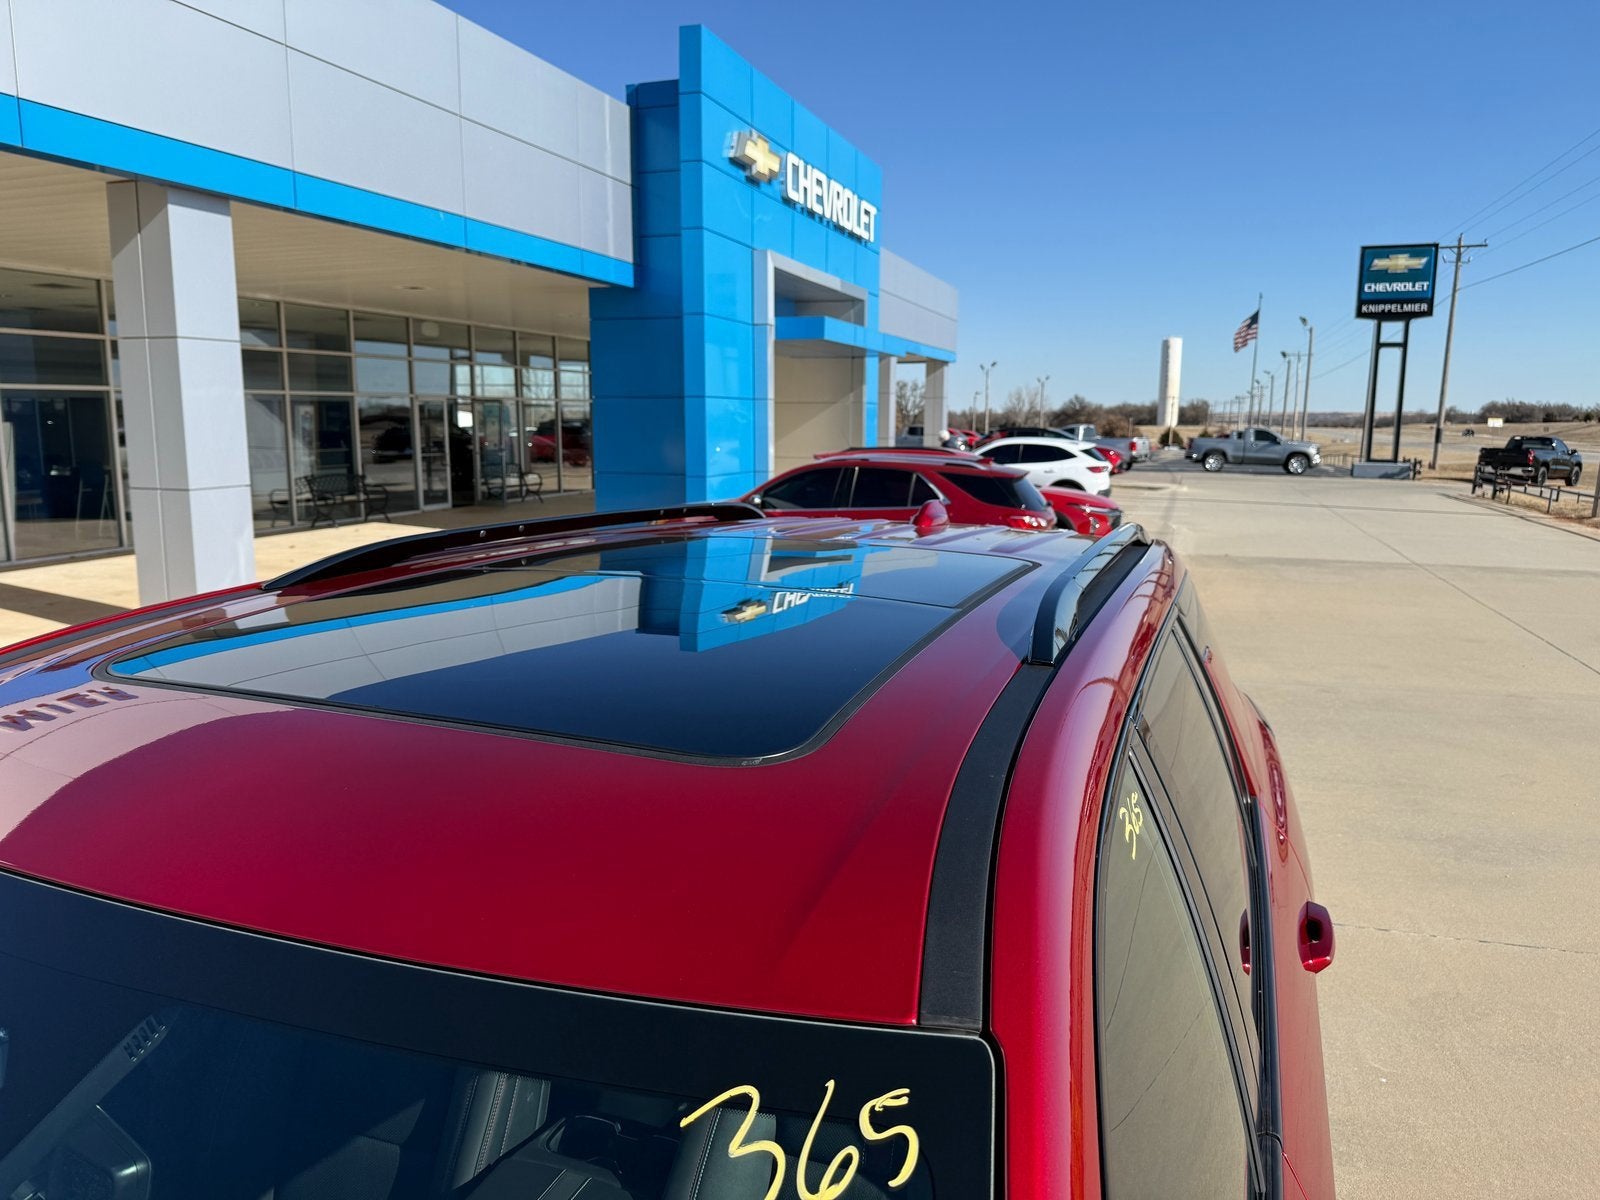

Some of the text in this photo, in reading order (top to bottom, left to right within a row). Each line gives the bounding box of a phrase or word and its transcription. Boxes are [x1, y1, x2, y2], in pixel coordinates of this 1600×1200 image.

[786, 152, 877, 242] CHEVROLET
[1361, 303, 1428, 314] KNIPPELMIER
[1364, 281, 1430, 293] CHEVROLET
[1119, 791, 1143, 860] 365
[680, 1079, 919, 1200] 365
